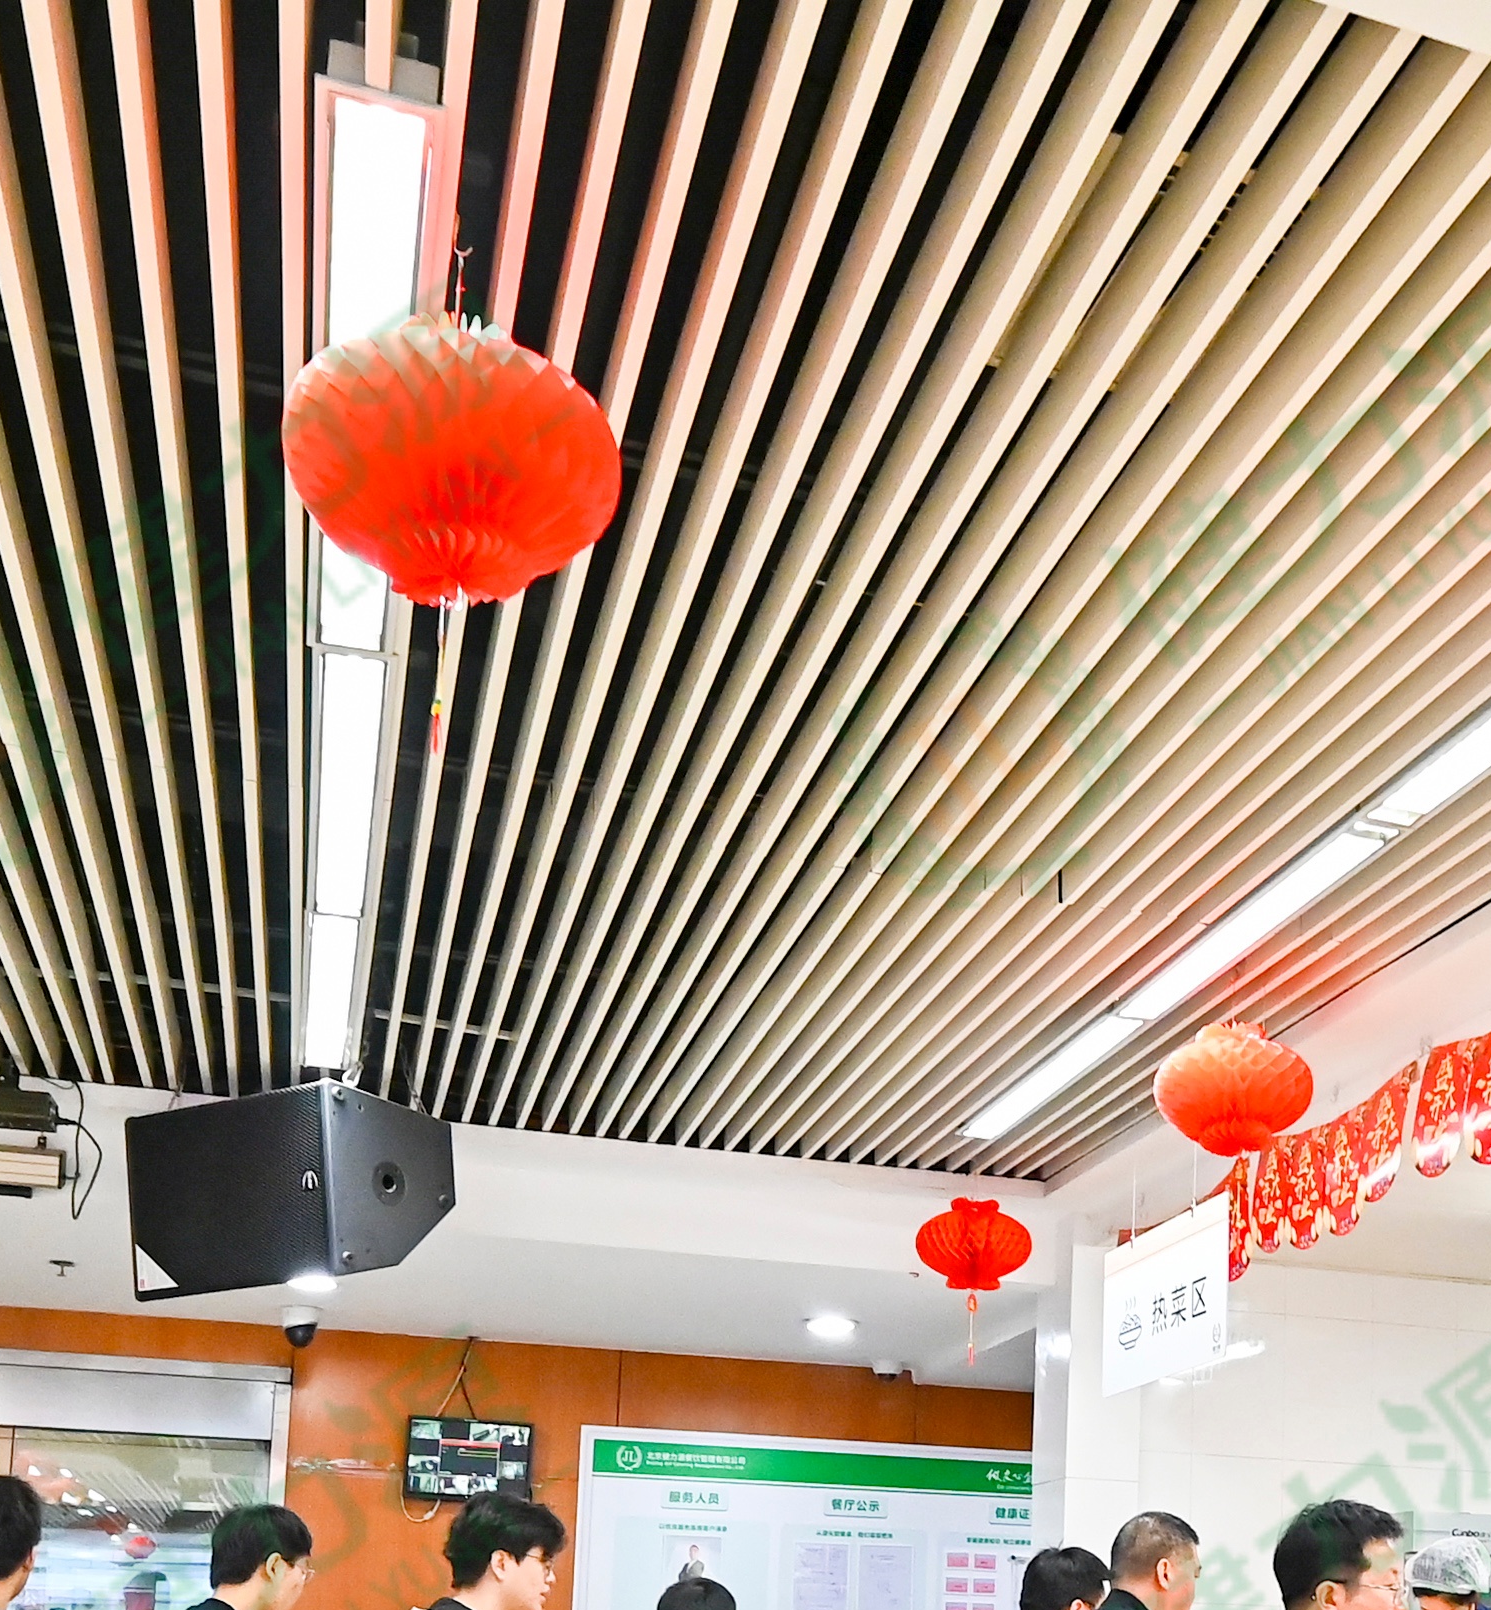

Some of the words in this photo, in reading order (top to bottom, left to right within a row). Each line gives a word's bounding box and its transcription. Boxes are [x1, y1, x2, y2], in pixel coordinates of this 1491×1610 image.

[1151, 1276, 1207, 1336] 热菜区
[669, 1491, 719, 1505] 服务人员
[831, 1498, 880, 1513] 餐厅公示
